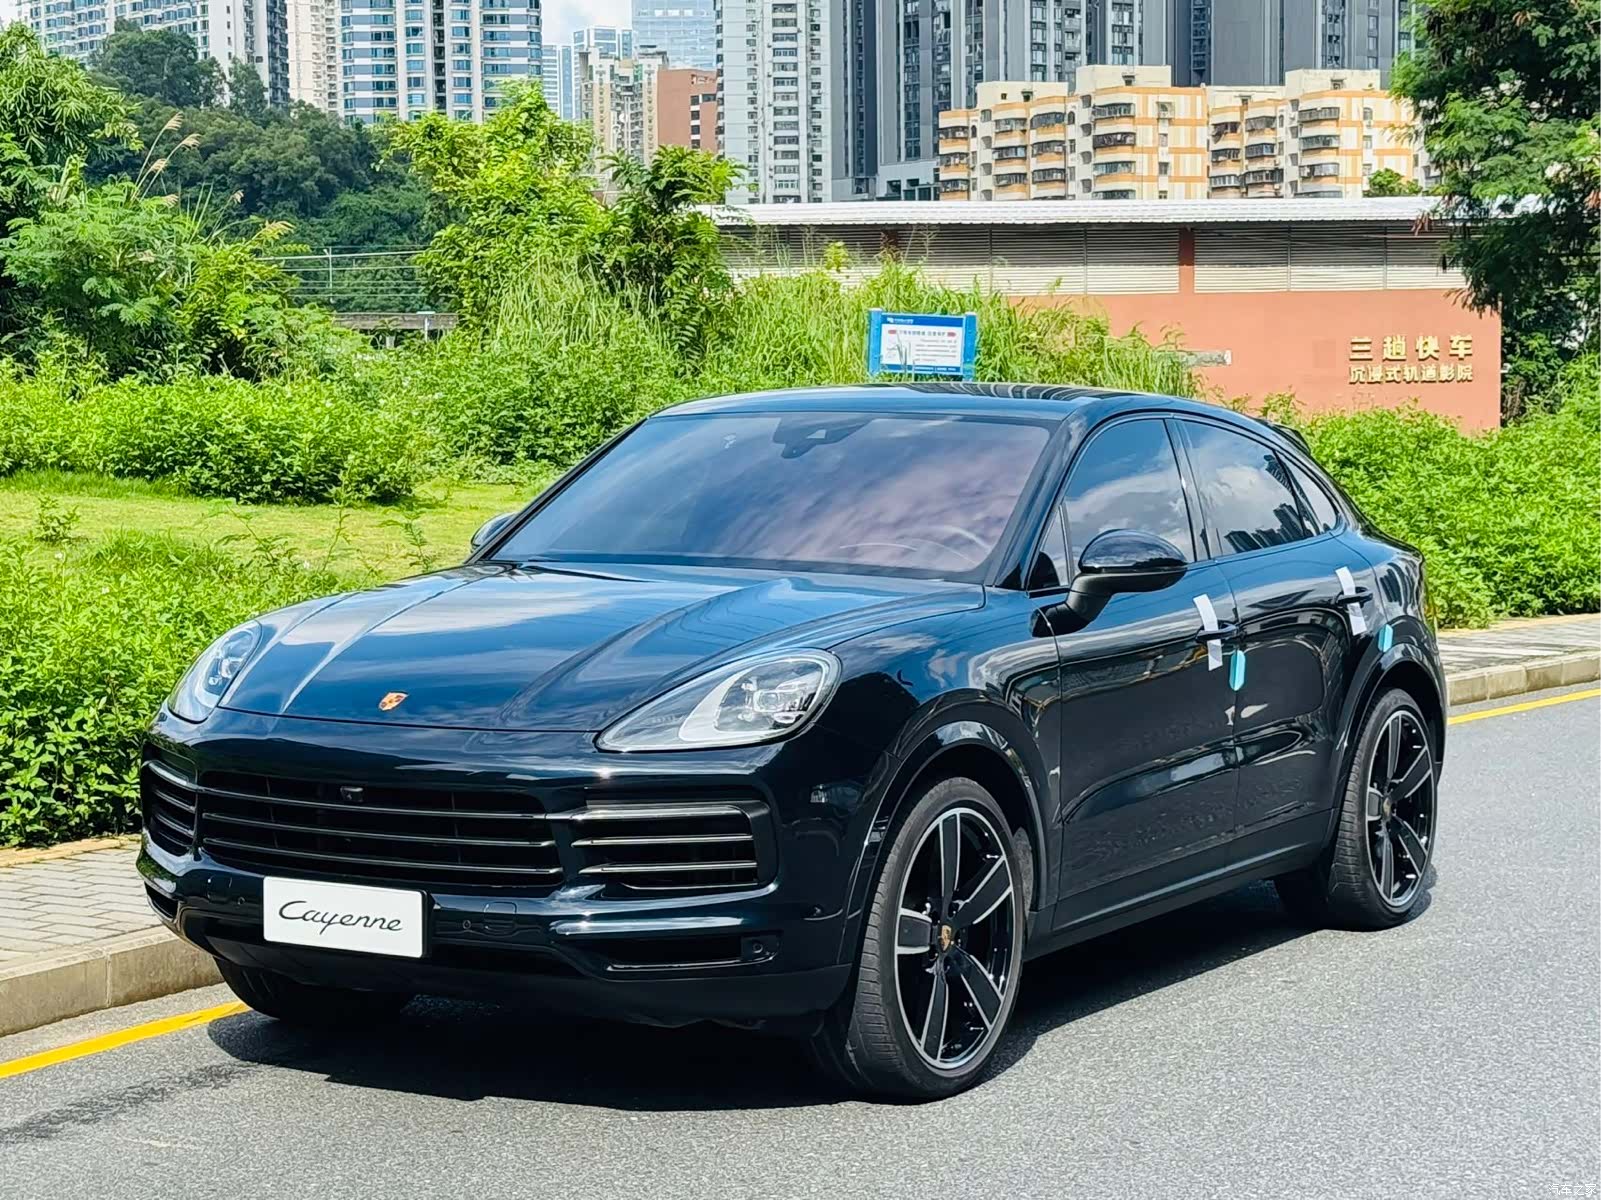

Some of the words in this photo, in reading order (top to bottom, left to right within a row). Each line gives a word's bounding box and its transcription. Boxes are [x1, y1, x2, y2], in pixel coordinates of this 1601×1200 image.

[1349, 364, 1473, 384] 沉浸式轨道影院
[279, 900, 403, 935] Cayenne
